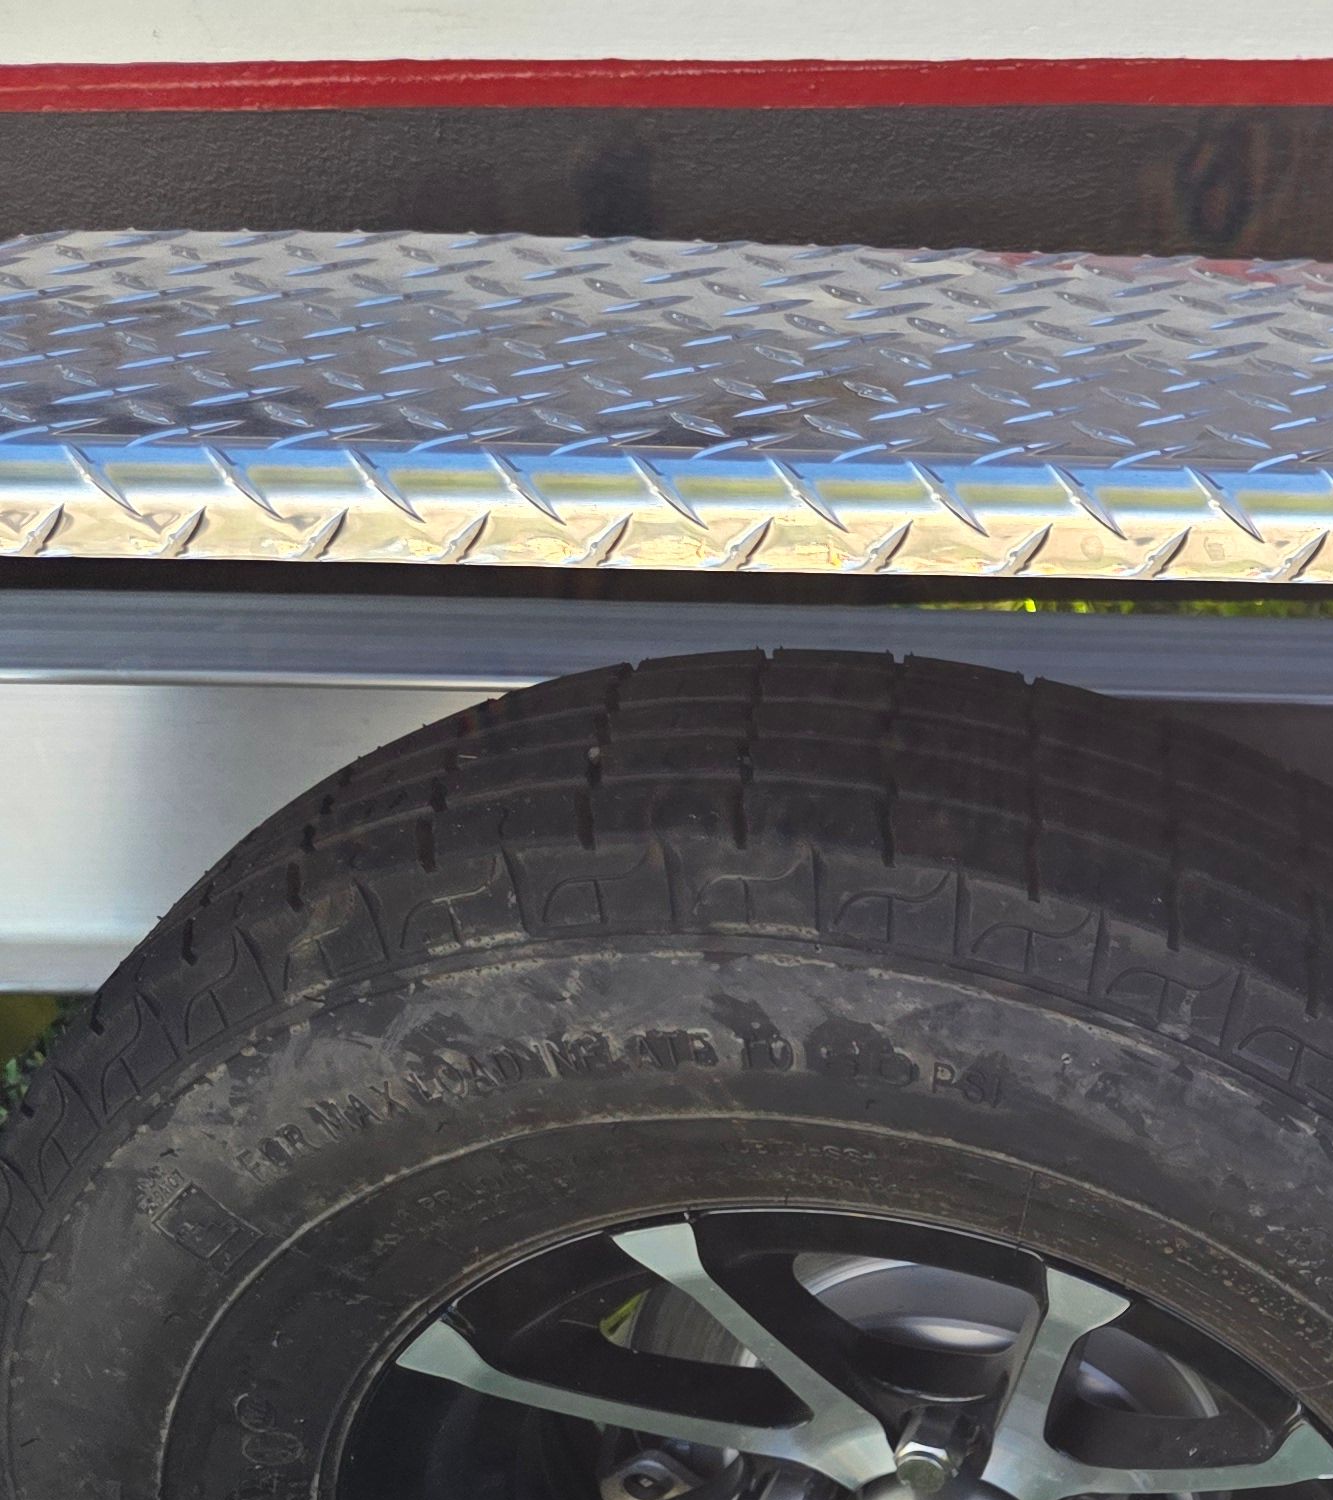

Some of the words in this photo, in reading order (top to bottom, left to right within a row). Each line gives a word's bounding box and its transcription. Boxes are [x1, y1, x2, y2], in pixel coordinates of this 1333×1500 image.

[233, 1120, 309, 1183] FOR
[313, 1079, 410, 1140] MAX
[406, 1046, 525, 1105] LOAD
[931, 1055, 1008, 1109] PSI
